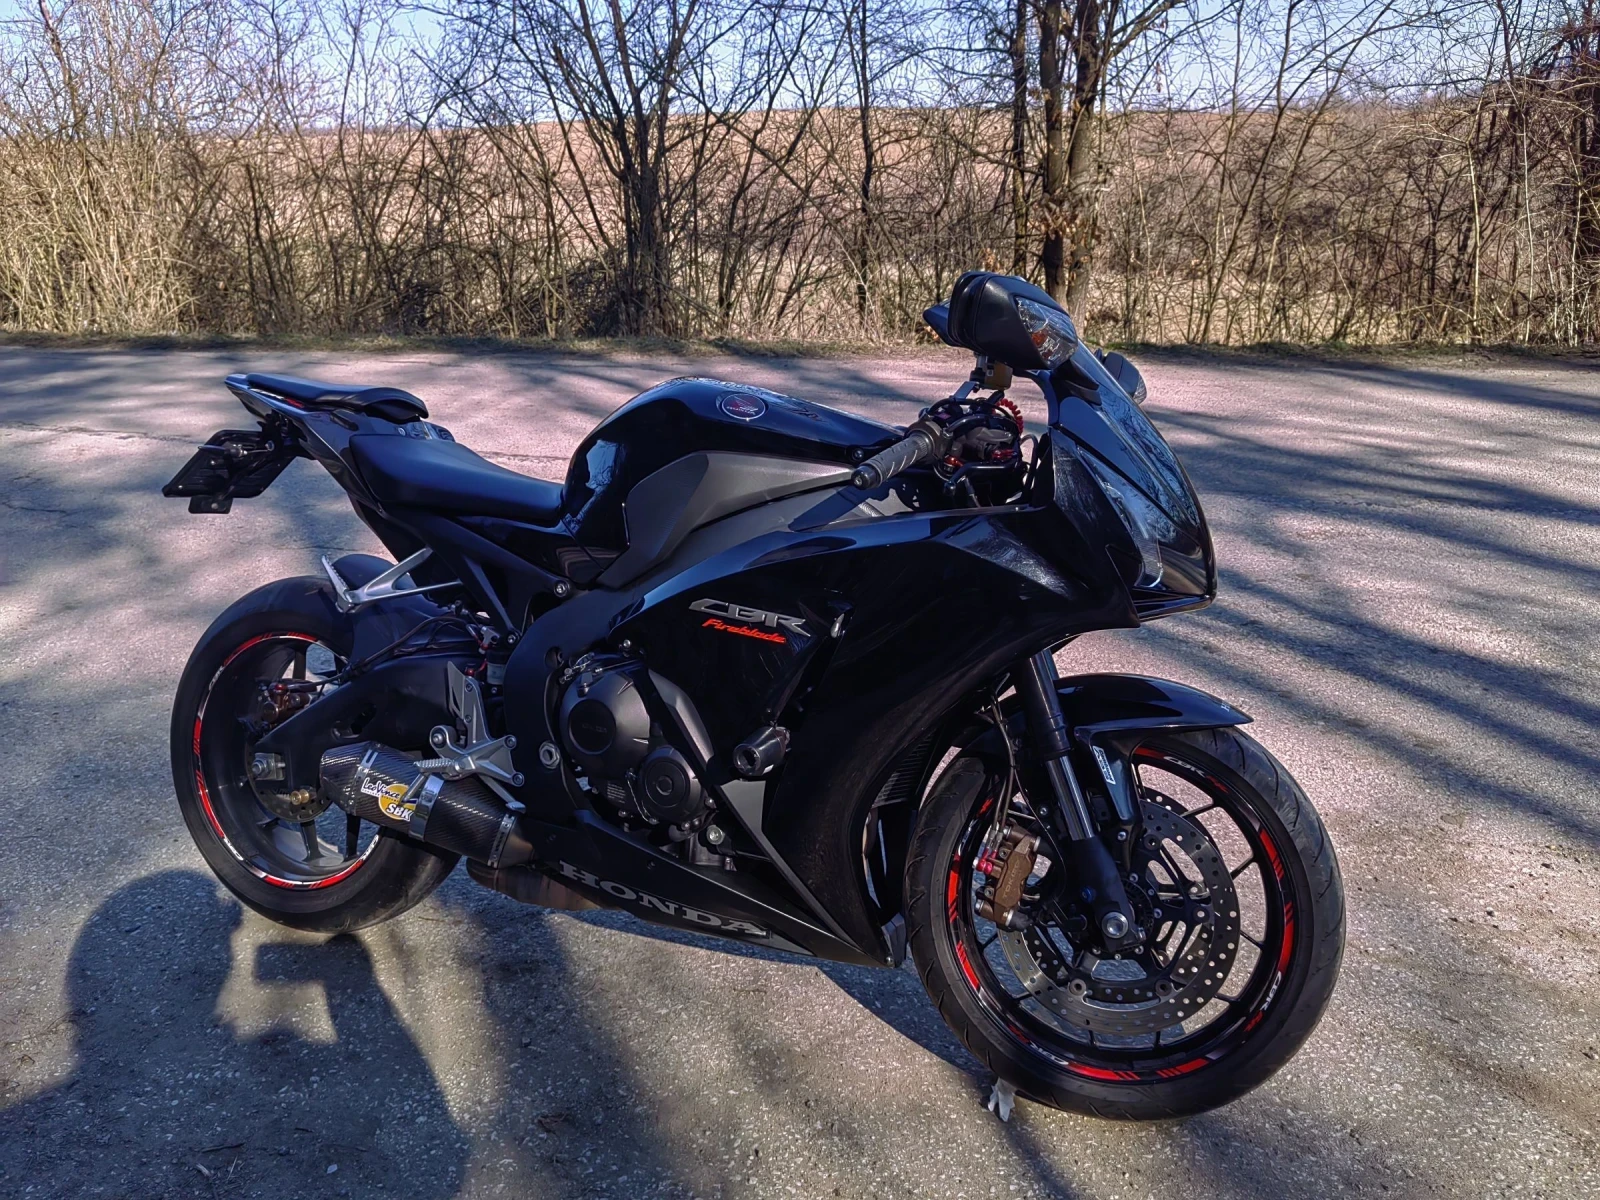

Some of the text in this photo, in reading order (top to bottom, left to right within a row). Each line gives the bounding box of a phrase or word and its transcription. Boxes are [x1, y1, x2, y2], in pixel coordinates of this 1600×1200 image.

[689, 598, 811, 637] CBR
[702, 618, 786, 643] Fireblade
[361, 777, 401, 799] LeoVince
[386, 802, 414, 822] SBK
[558, 860, 768, 937] HONDA
